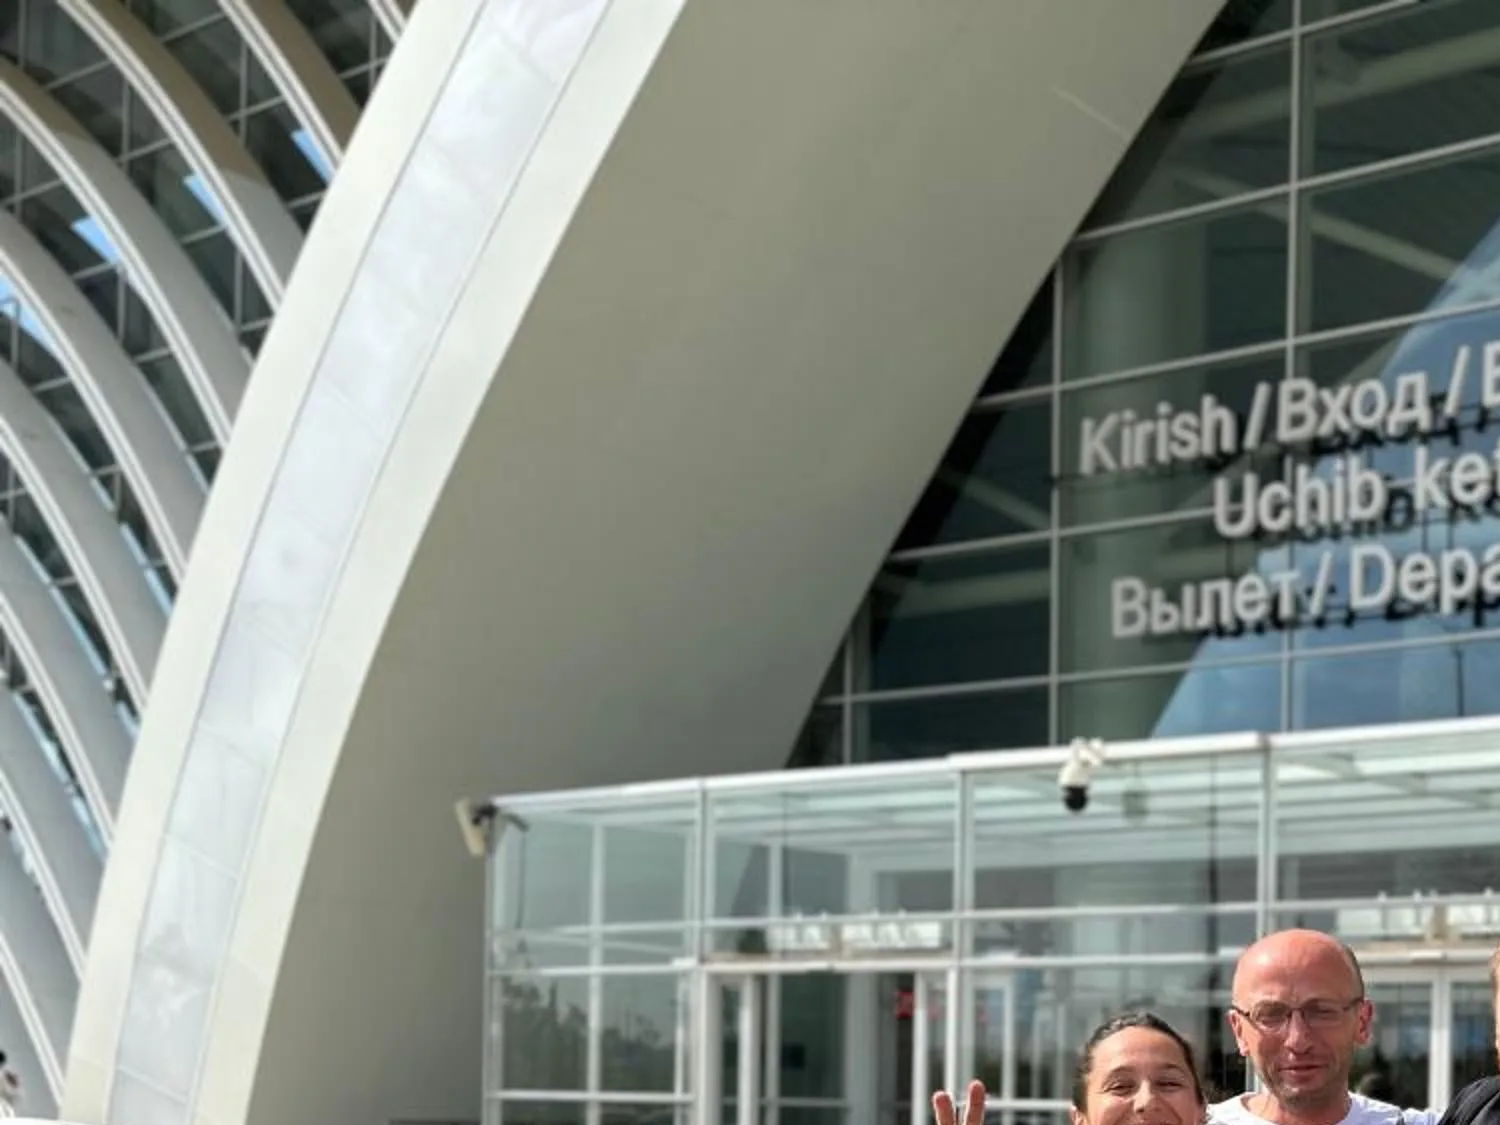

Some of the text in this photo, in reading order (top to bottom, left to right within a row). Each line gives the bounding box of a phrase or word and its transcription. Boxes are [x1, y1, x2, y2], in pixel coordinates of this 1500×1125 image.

[1080, 391, 1237, 475] Kirish
[1278, 371, 1431, 443] Вход
[1214, 465, 1386, 538] Uchib
[1111, 571, 1300, 638] Вылет
